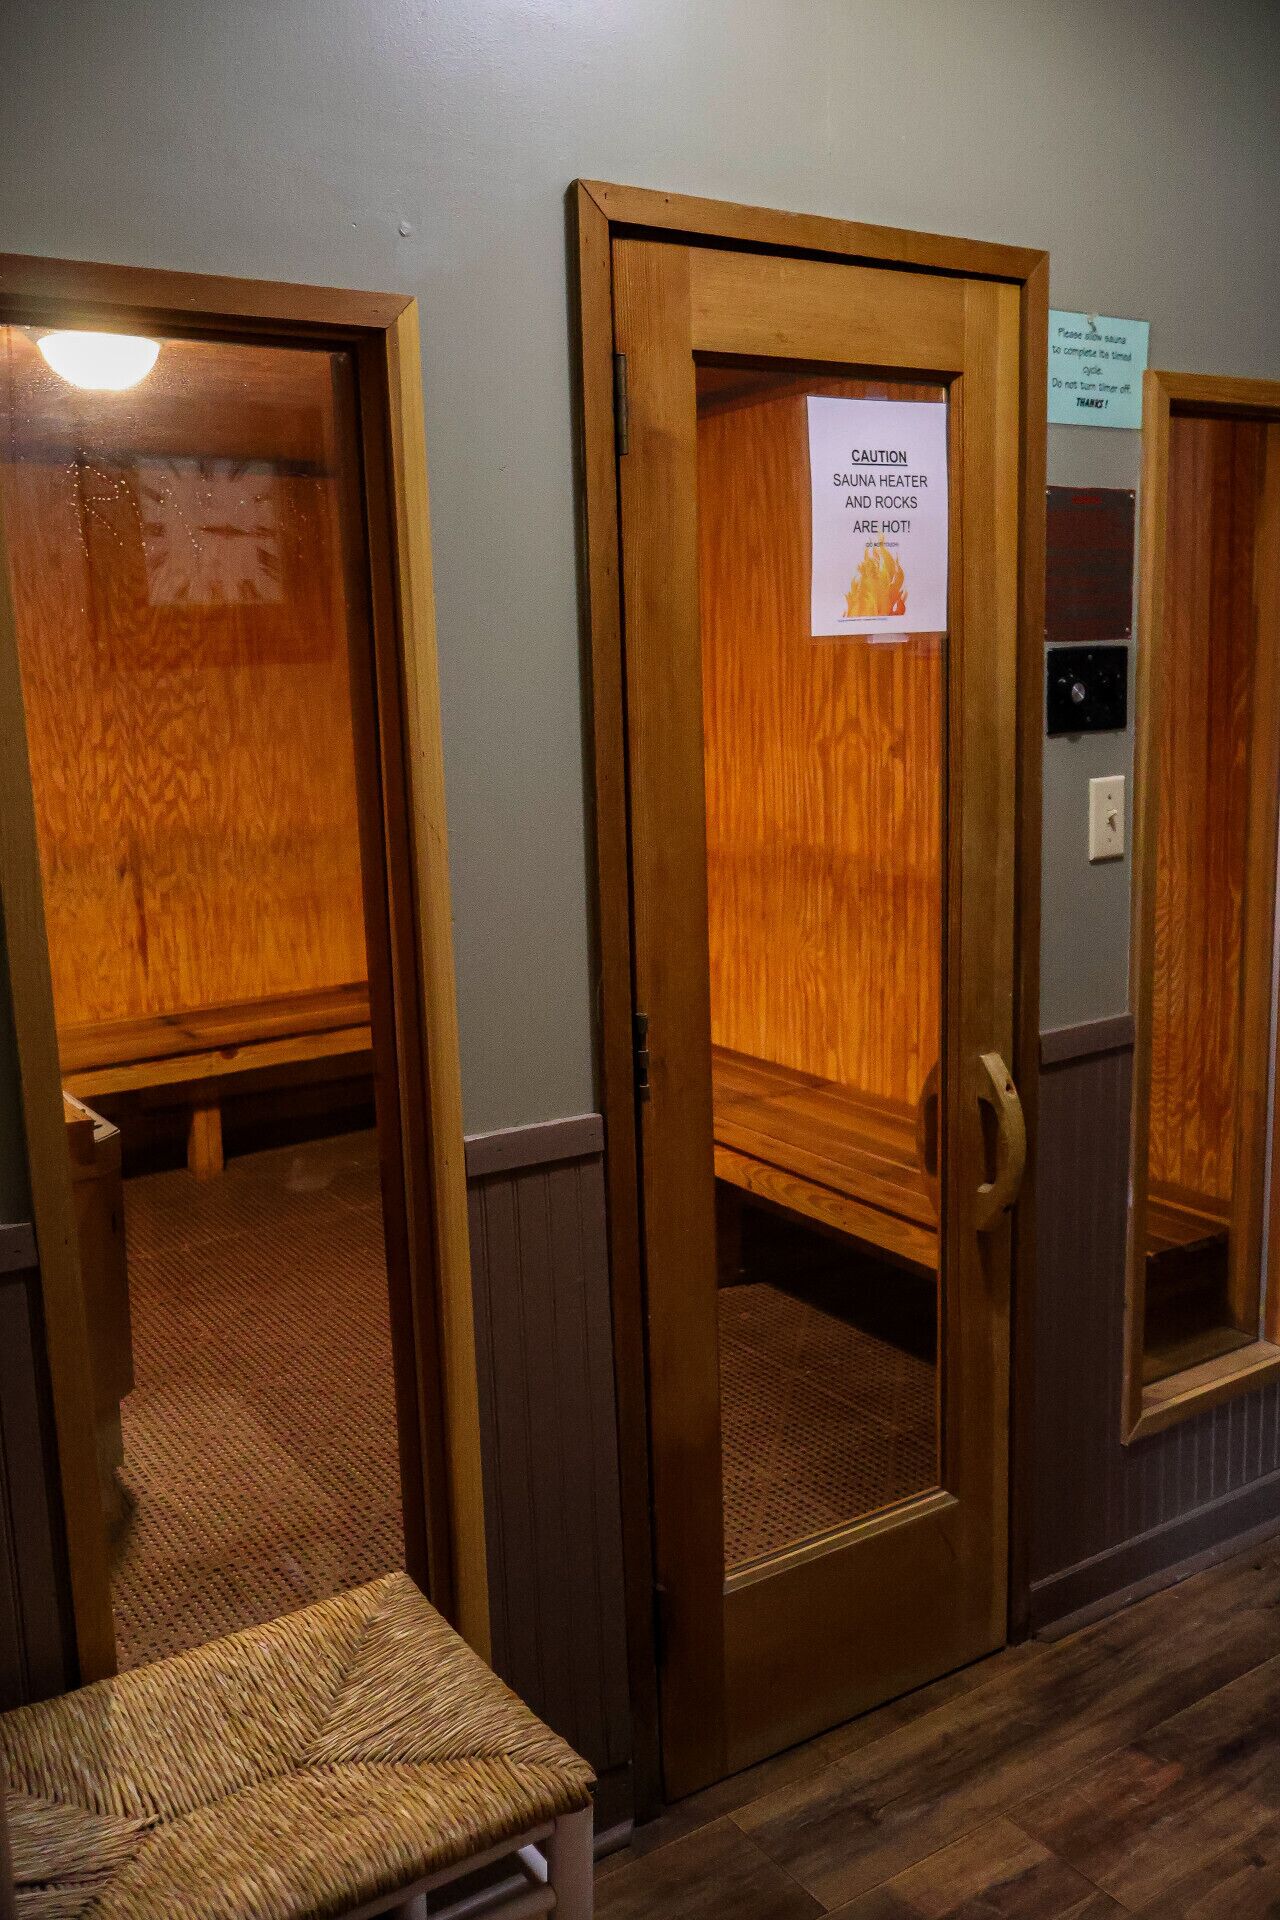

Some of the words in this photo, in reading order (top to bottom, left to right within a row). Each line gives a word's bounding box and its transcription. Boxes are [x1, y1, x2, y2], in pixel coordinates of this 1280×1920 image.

[1104, 335, 1126, 344] sauna
[1052, 345, 1061, 354] to
[1063, 347, 1096, 359] complete
[1112, 351, 1132, 361] timed
[1052, 377, 1062, 388] Do
[1064, 381, 1077, 389] not
[1080, 381, 1096, 390] turn
[1099, 383, 1118, 393] timer
[851, 449, 907, 464] CAUTION
[833, 473, 876, 487] SAUNA
[880, 474, 928, 488] HEATER
[845, 495, 871, 508] AND
[875, 495, 918, 509] ROCKS
[853, 520, 879, 533] ARE
[882, 520, 911, 533] HOT!
